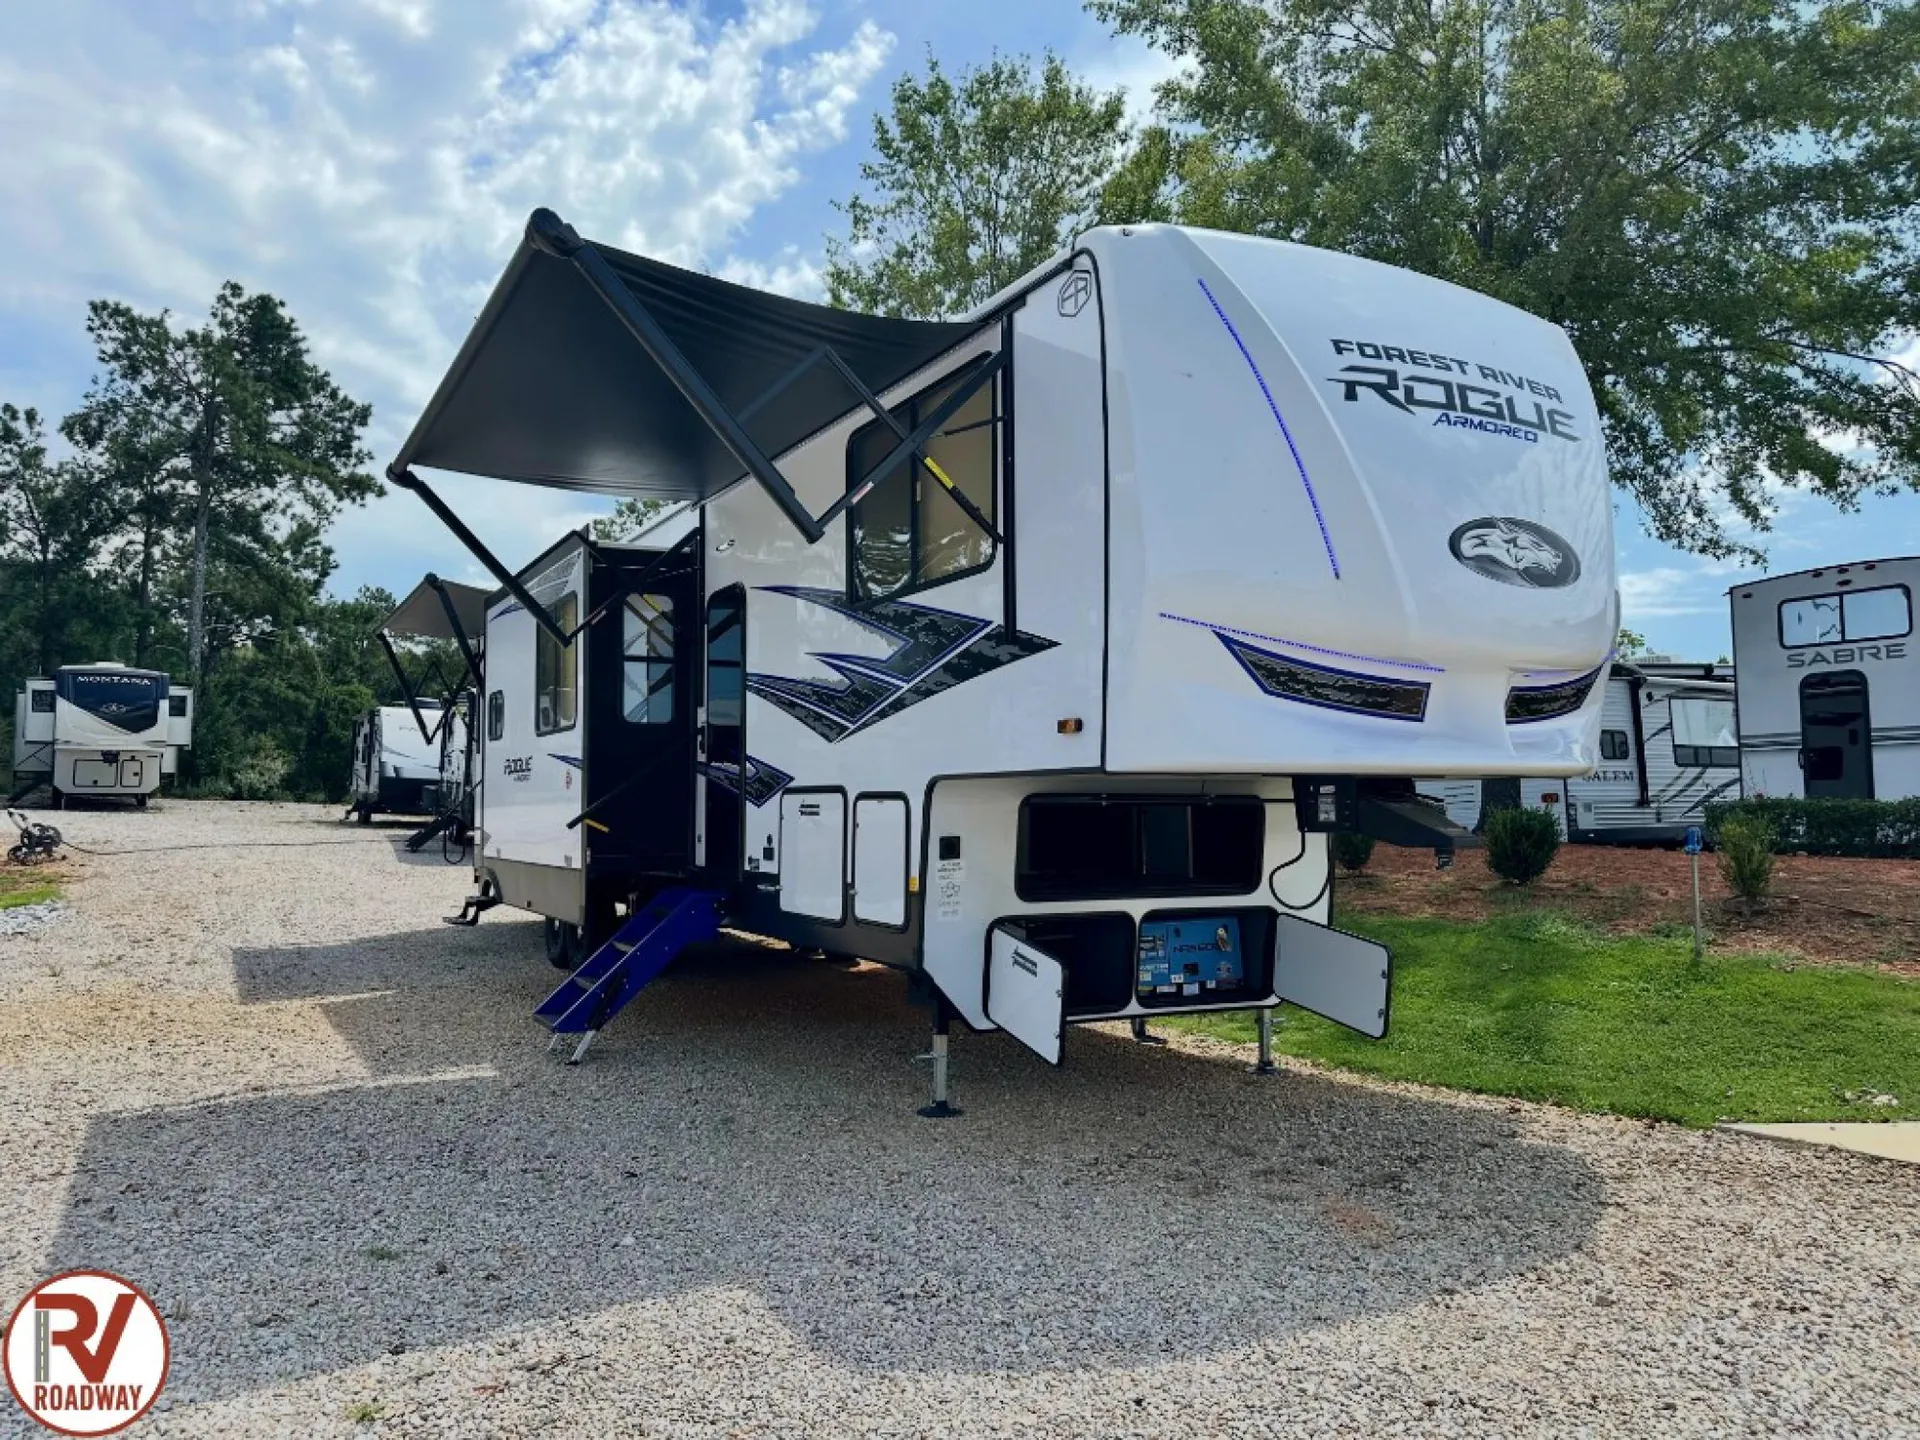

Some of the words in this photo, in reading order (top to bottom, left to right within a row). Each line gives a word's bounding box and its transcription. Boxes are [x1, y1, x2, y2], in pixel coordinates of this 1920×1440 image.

[1330, 338, 1469, 376] FOREST
[1475, 363, 1563, 404] RIVER
[1326, 365, 1581, 442] ROGUE
[1786, 643, 1907, 668] SABRE
[77, 676, 151, 685] MONTANA
